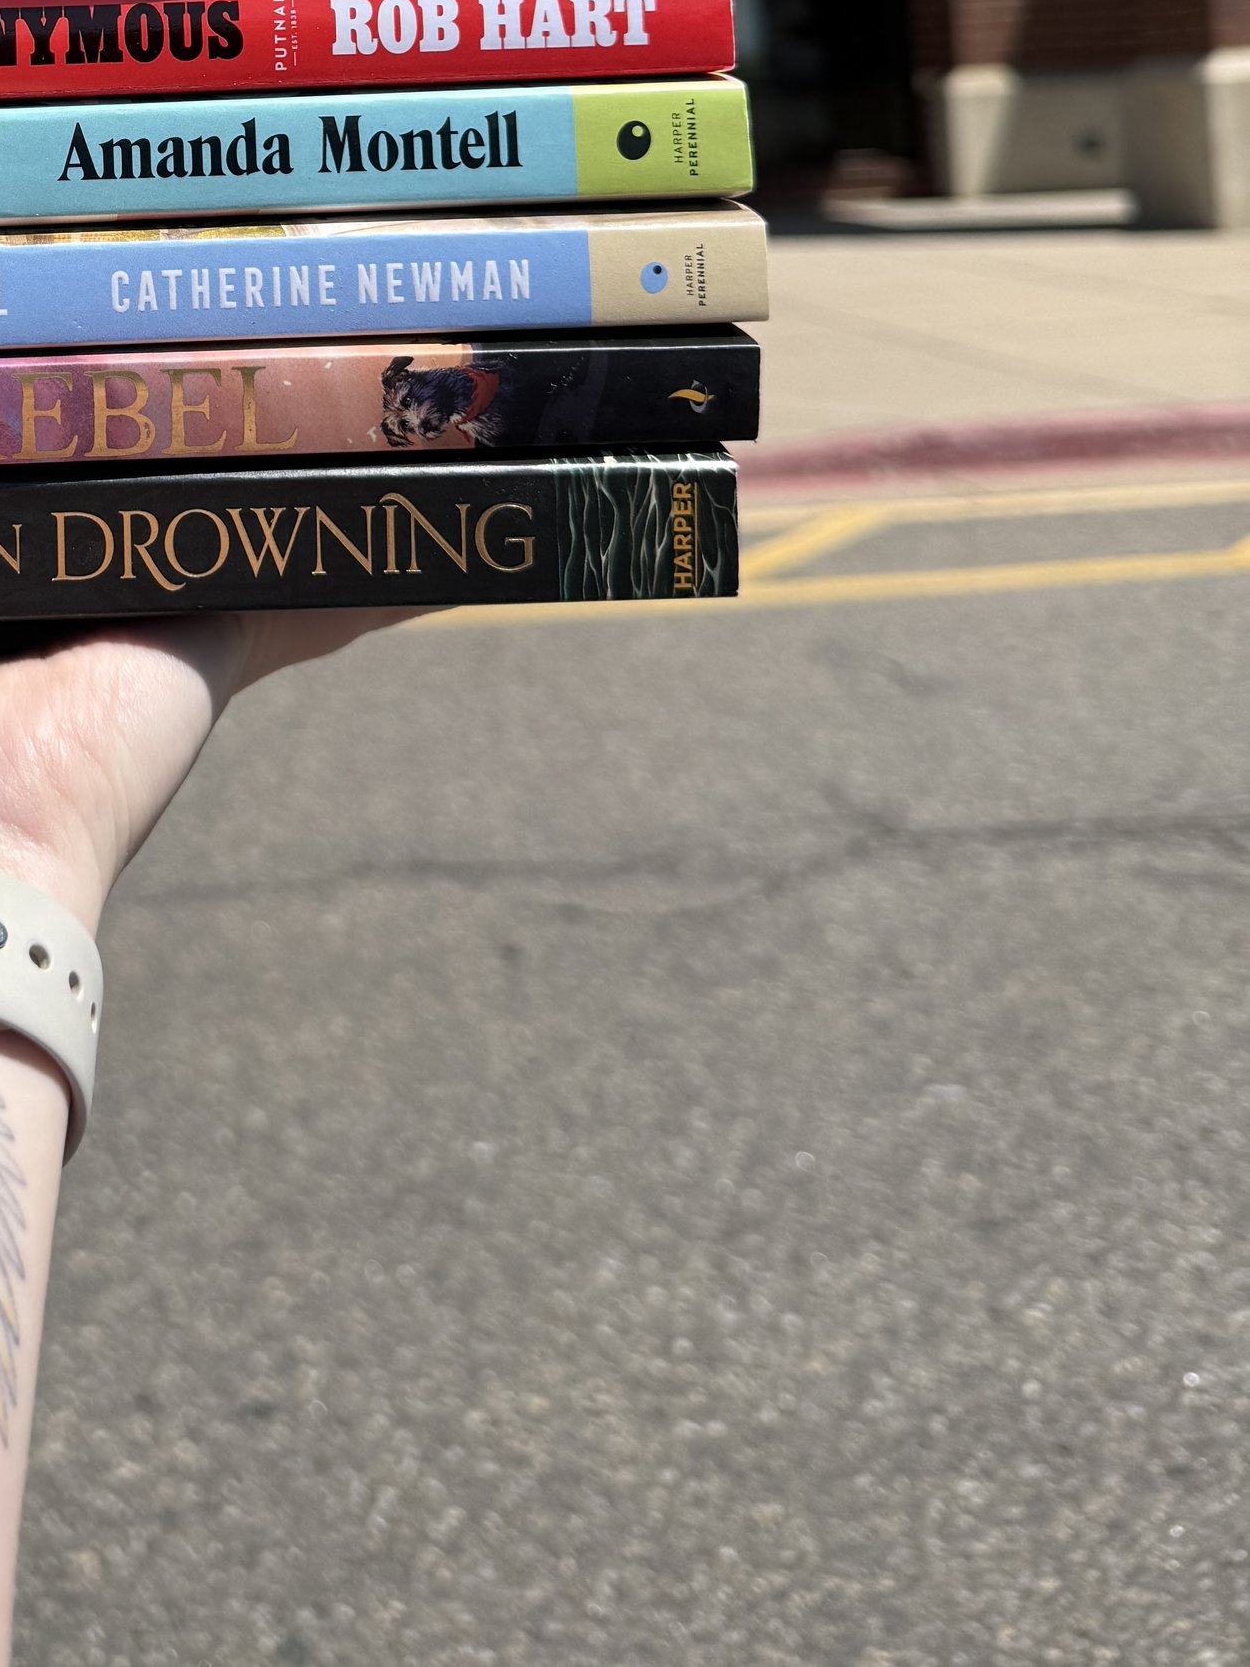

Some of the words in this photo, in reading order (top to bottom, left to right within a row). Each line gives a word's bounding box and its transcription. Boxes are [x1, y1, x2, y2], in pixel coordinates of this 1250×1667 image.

[57, 116, 294, 182] Amanda
[317, 110, 523, 174] Montell
[671, 112, 684, 164] HARPER
[685, 98, 699, 176] PERENNIAL
[110, 263, 337, 314] CATHERINE
[357, 258, 532, 306] NEWMAN
[684, 254, 695, 296] HARPER
[695, 243, 707, 307] PERENNIAL
[51, 491, 537, 592] DROWNING
[672, 482, 693, 589] HARPER
